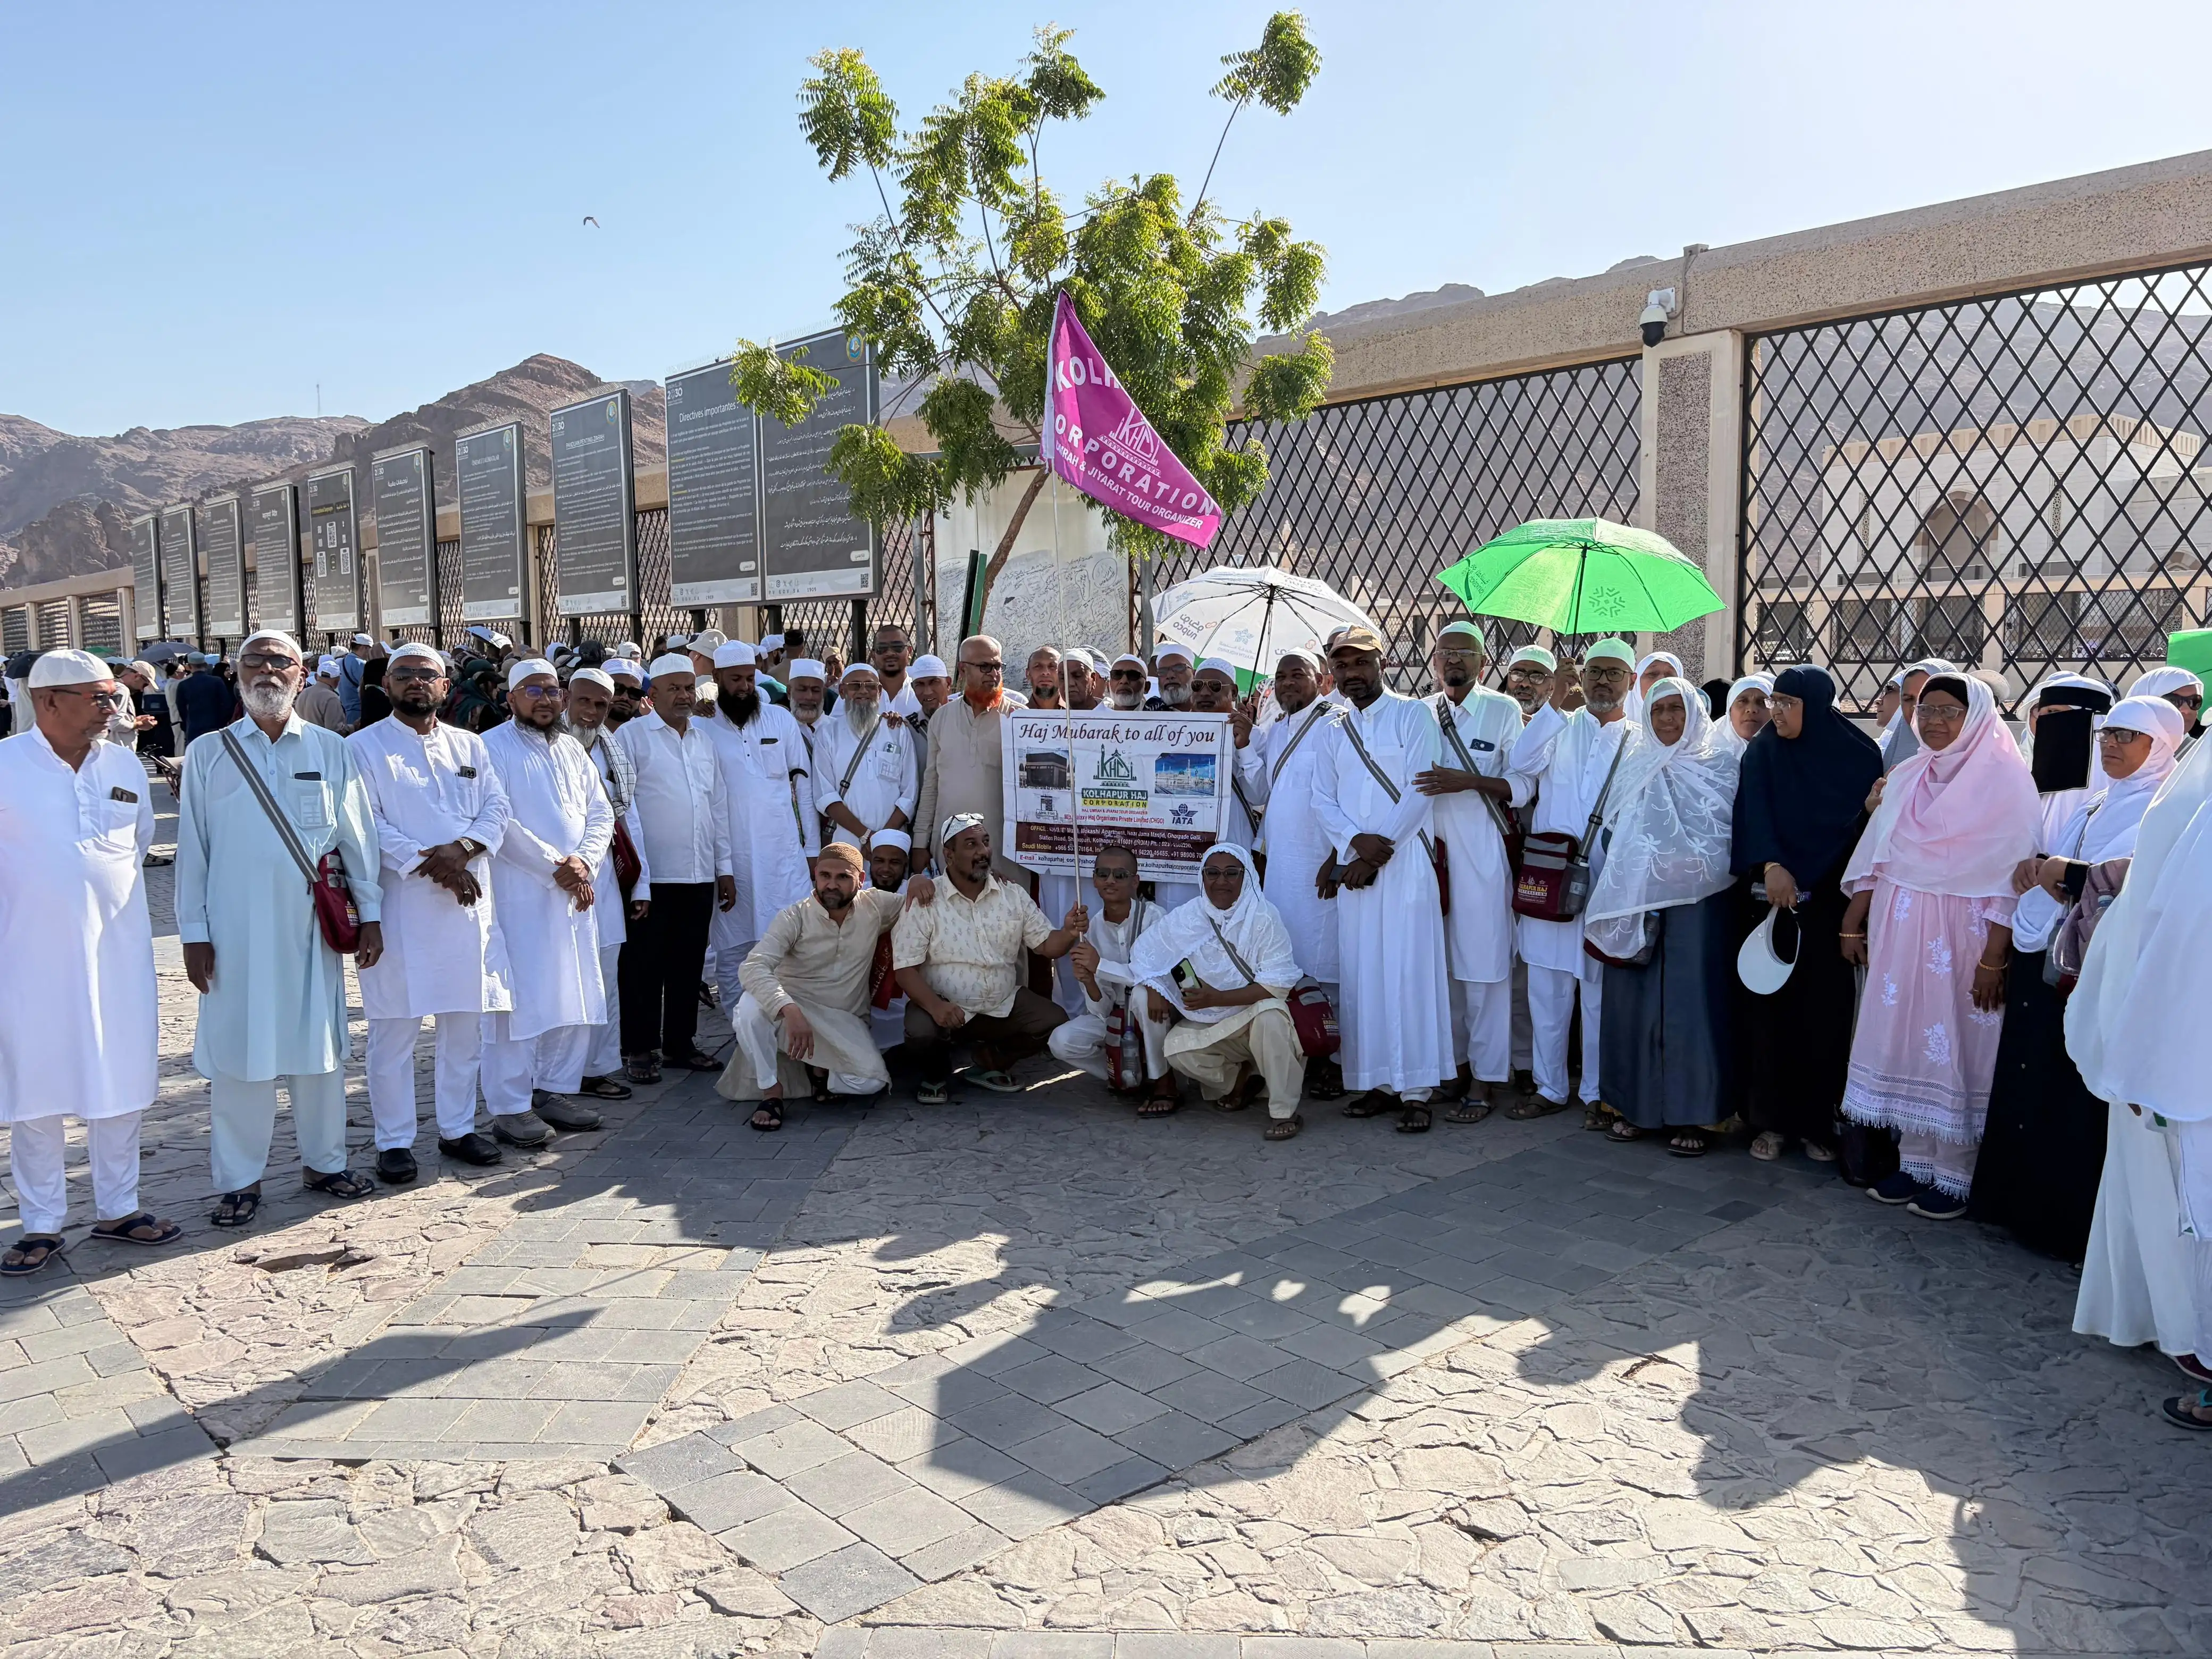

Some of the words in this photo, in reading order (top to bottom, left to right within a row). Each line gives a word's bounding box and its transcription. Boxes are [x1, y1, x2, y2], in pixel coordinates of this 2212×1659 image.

[679, 409, 703, 423] Directives
[704, 403, 736, 417] importantes
[1055, 414, 1214, 516] ORPORATION
[1079, 460, 1086, 472] &
[1088, 468, 1126, 498] JIYARAT
[1127, 491, 1152, 512] TOUR
[1152, 504, 1204, 530] ORGANIZER
[1019, 723, 1049, 743] Haj
[1051, 723, 1124, 744] Mubarak
[1125, 727, 1139, 740] to
[1144, 725, 1167, 741] all
[1168, 725, 1187, 746] of
[1185, 731, 1214, 747] you
[1083, 790, 1128, 799] KOLHAPUR
[1131, 791, 1147, 800] HAJ
[1083, 799, 1147, 808] CORPORATION
